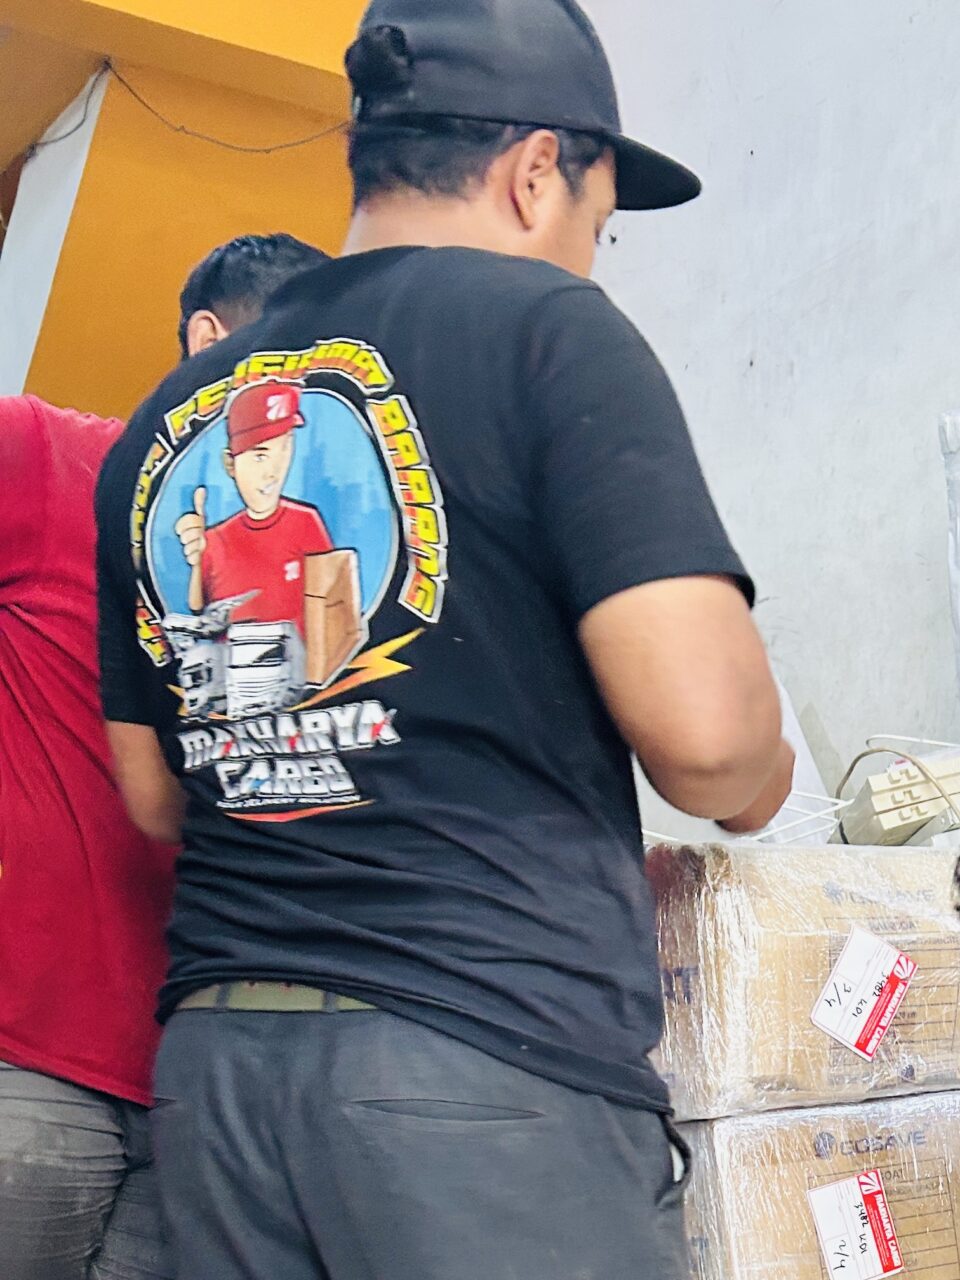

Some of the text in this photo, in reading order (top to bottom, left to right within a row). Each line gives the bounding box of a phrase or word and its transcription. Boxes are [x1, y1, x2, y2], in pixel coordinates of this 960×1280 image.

[215, 756, 361, 800] CARGO
[824, 982, 852, 1008] 3/4
[833, 1239, 849, 1271] 2/4
